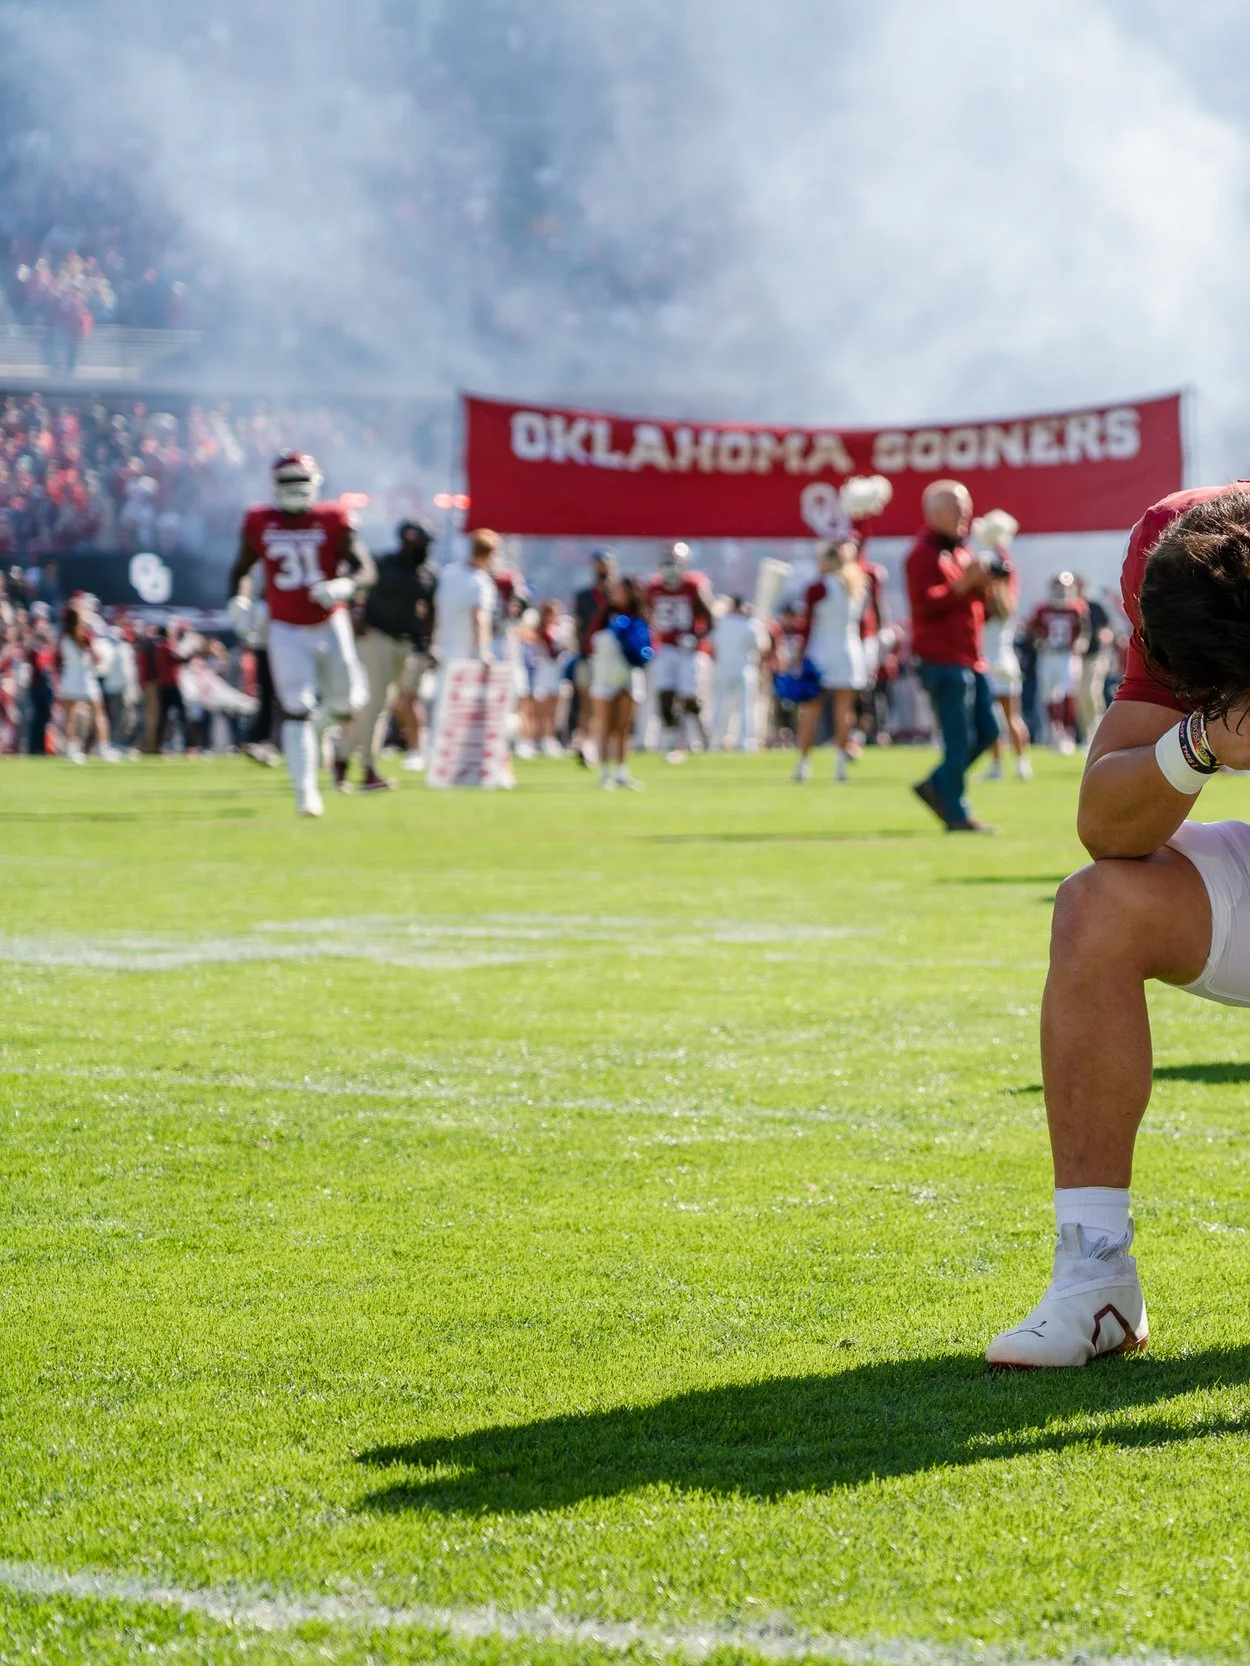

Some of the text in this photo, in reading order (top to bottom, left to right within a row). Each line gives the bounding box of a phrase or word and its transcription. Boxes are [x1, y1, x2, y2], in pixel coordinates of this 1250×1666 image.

[510, 406, 1142, 475] OKLAHOMA SOONERS
[265, 541, 326, 591] 31
